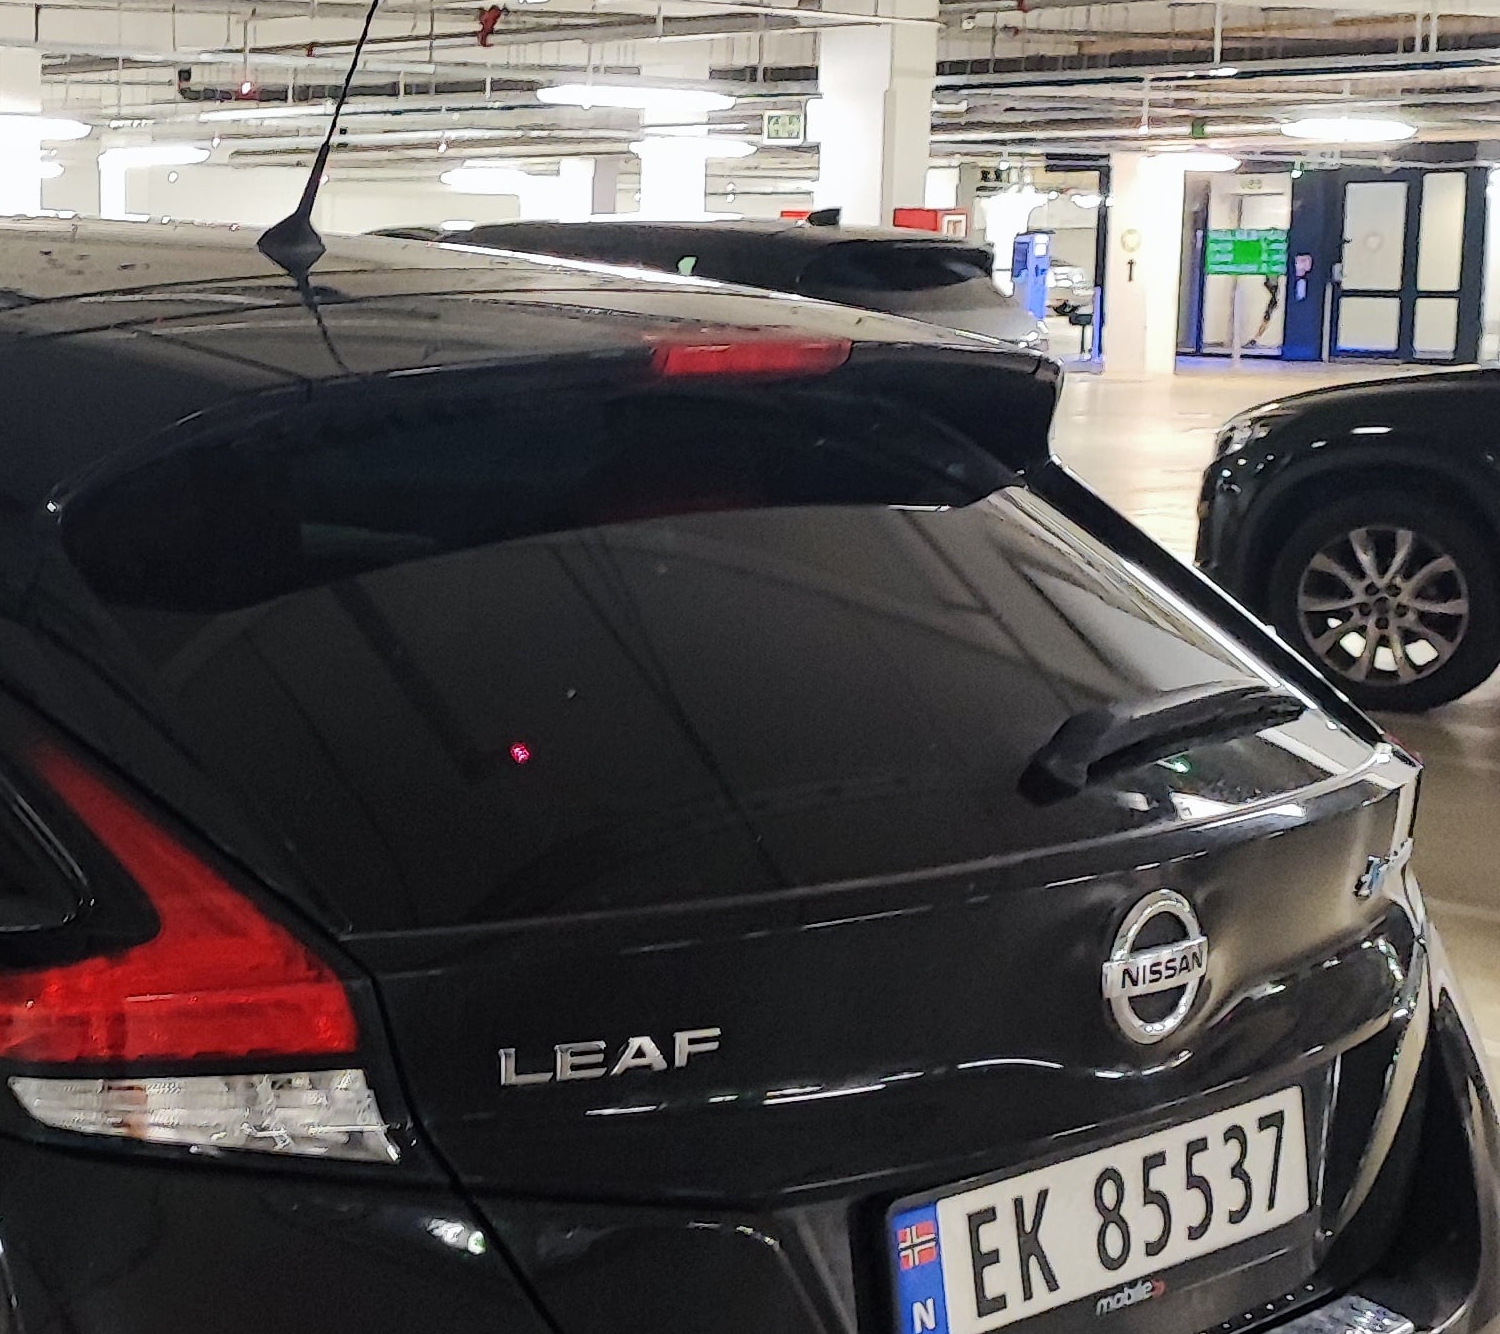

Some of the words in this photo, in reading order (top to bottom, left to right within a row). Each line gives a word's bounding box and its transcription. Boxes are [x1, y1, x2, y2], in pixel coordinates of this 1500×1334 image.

[1121, 949, 1203, 989] NISSAN
[498, 1027, 723, 1086] LEAF
[966, 1189, 1060, 1318] EK
[1094, 1110, 1285, 1271] 85537
[912, 1298, 936, 1334] N
